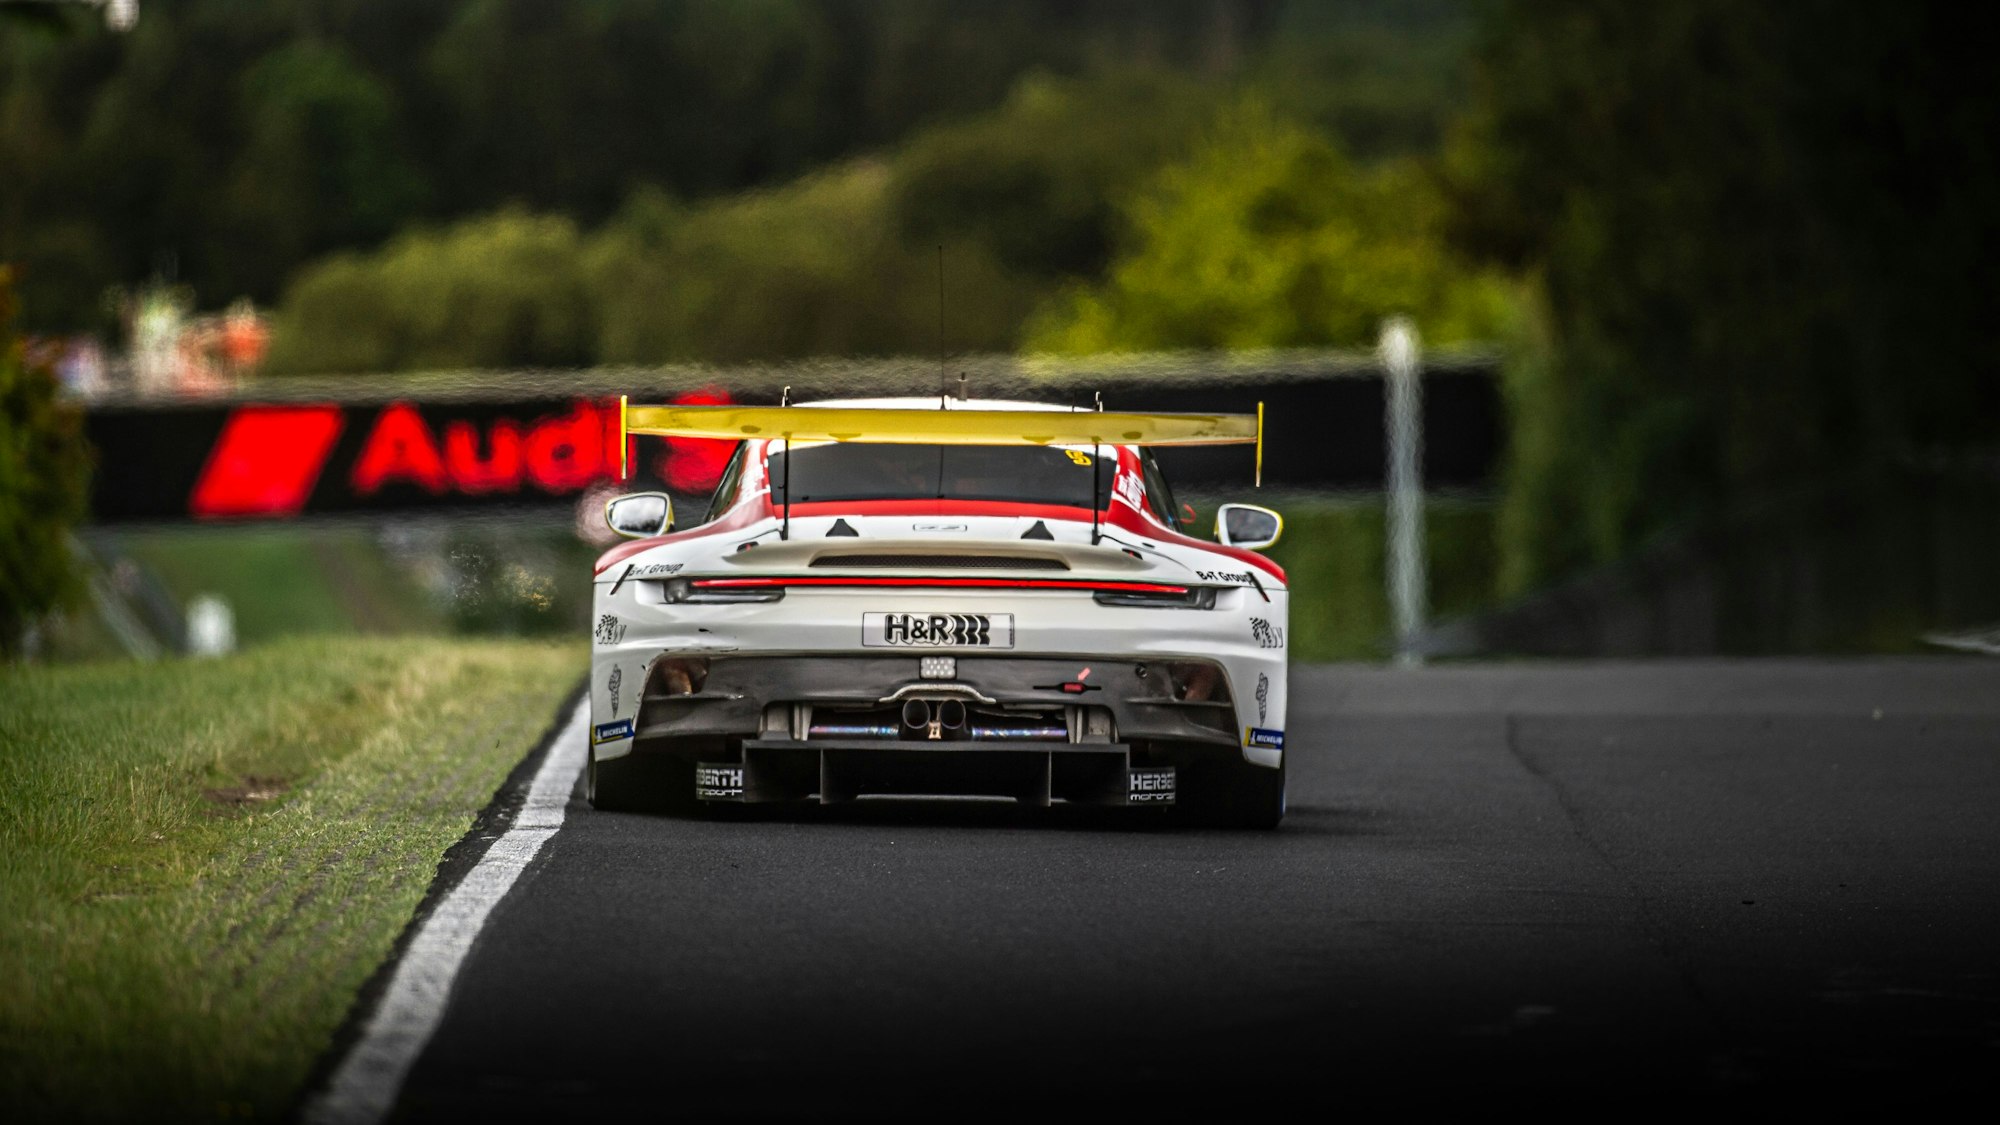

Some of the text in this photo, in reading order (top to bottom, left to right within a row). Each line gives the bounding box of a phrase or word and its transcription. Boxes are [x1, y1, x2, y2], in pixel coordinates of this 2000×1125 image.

[353, 397, 637, 493] Audi
[649, 563, 684, 574] Group
[885, 614, 956, 645] H&R
[602, 725, 628, 737] MICHELIN
[1256, 733, 1283, 744] MICHELIN
